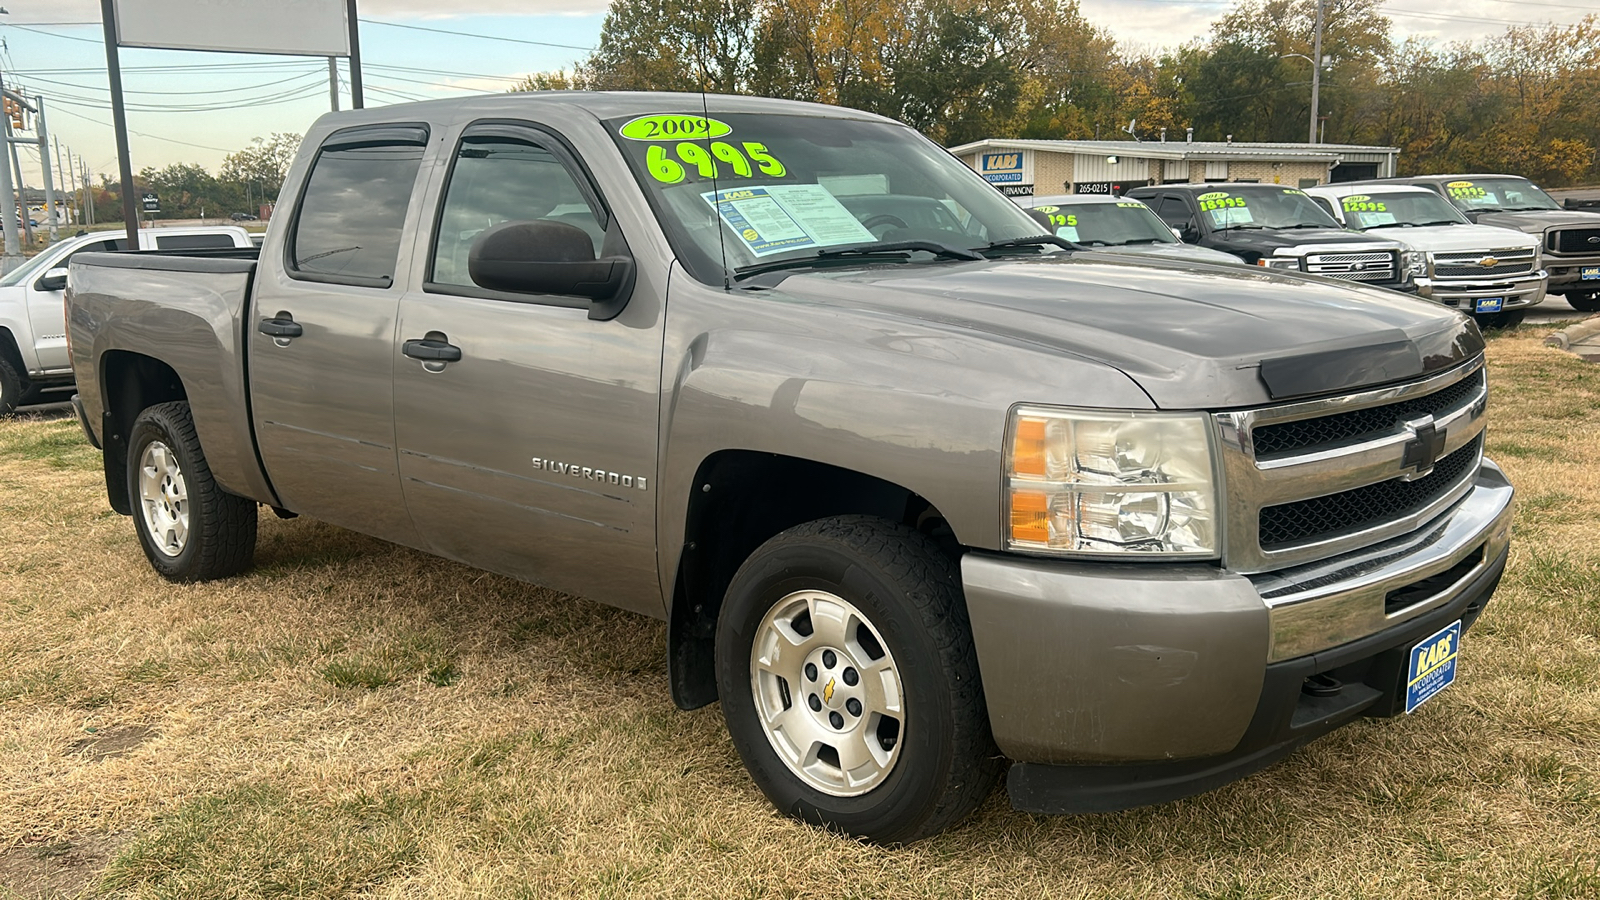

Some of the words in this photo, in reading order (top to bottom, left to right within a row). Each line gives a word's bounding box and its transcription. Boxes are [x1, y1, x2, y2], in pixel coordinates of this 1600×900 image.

[644, 118, 711, 138] 2009
[646, 141, 787, 184] 6995
[987, 154, 1018, 170] KARS
[724, 190, 754, 200] KARS
[1079, 183, 1108, 193] 265-0215
[1448, 187, 1486, 197] 19995
[1200, 197, 1246, 212] 18995
[1343, 202, 1387, 213] 12995
[532, 457, 633, 488] SILVERADO
[1416, 633, 1453, 677] KARS
[1412, 660, 1452, 693] INCORPORATED
